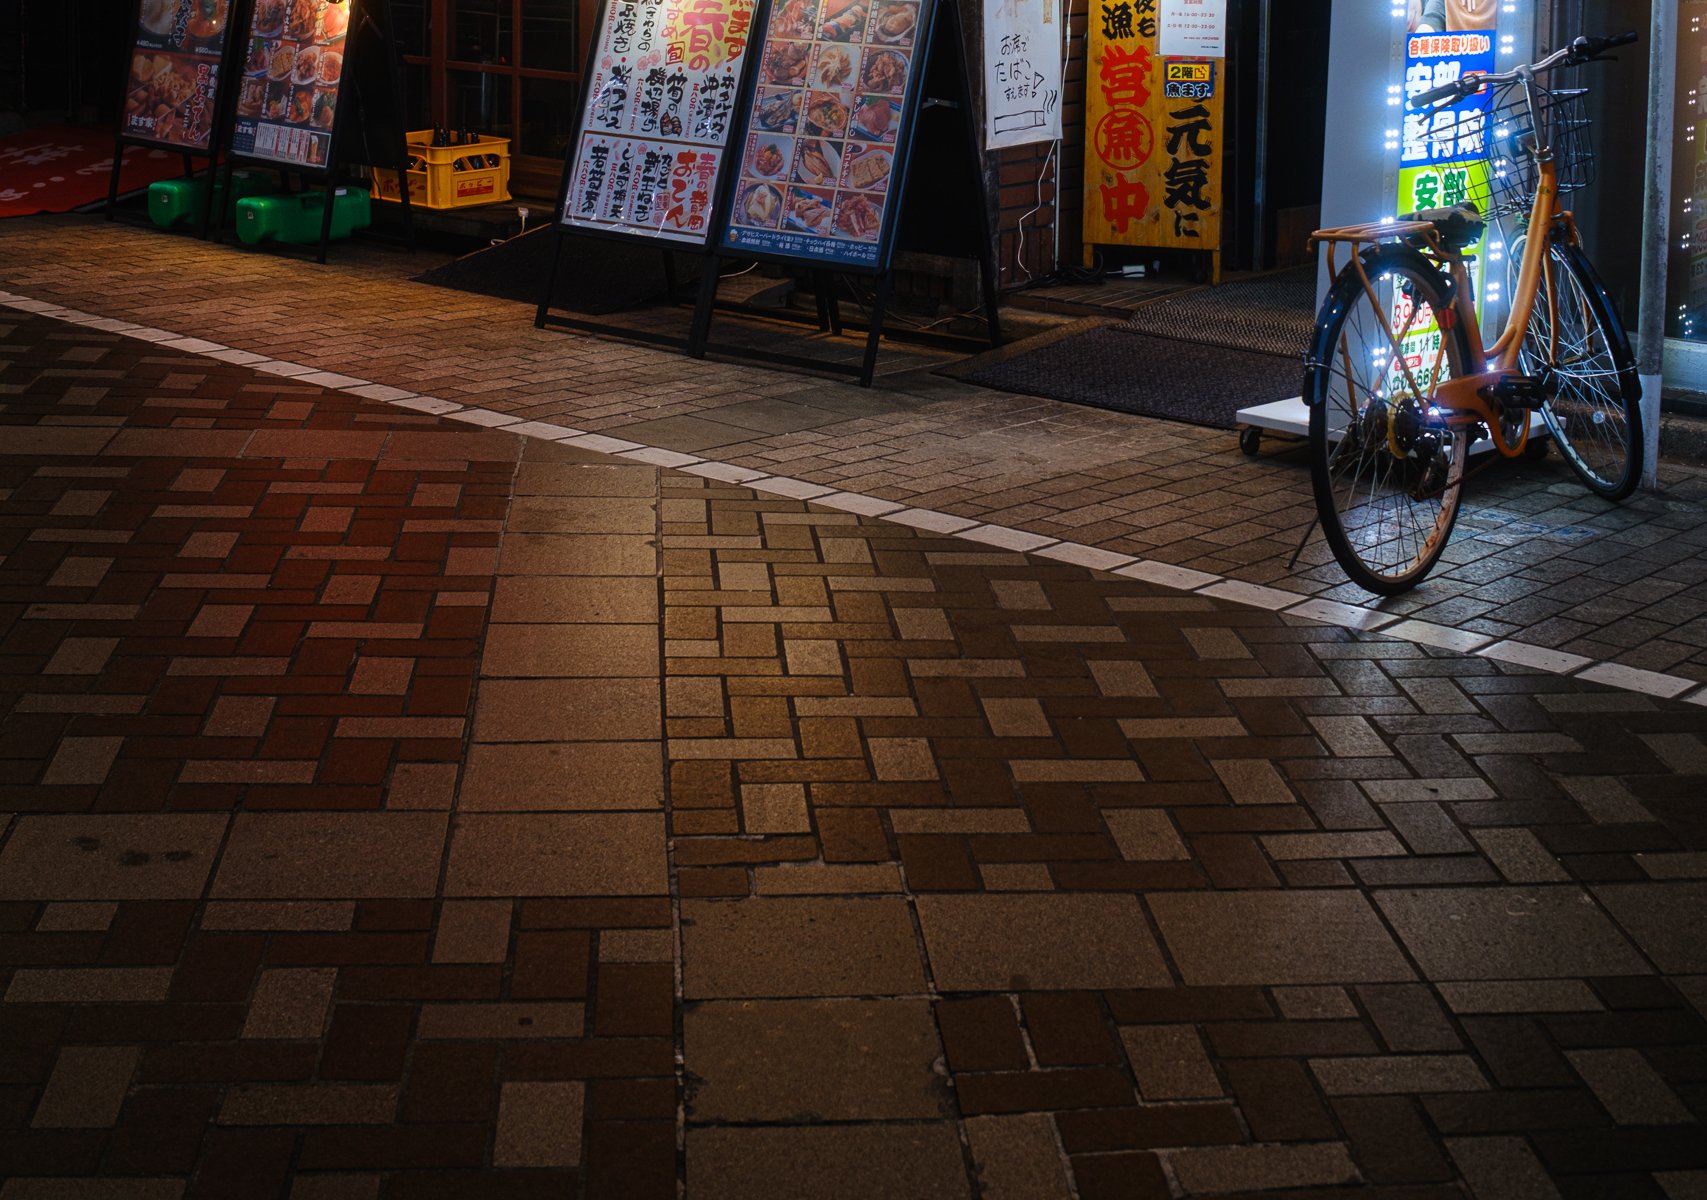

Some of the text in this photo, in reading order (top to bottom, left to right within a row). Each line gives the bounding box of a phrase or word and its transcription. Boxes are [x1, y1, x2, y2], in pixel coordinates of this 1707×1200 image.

[994, 57, 1031, 85] たばこ
[1170, 65, 1194, 80] 2階
[1166, 82, 1210, 98] 魚ます
